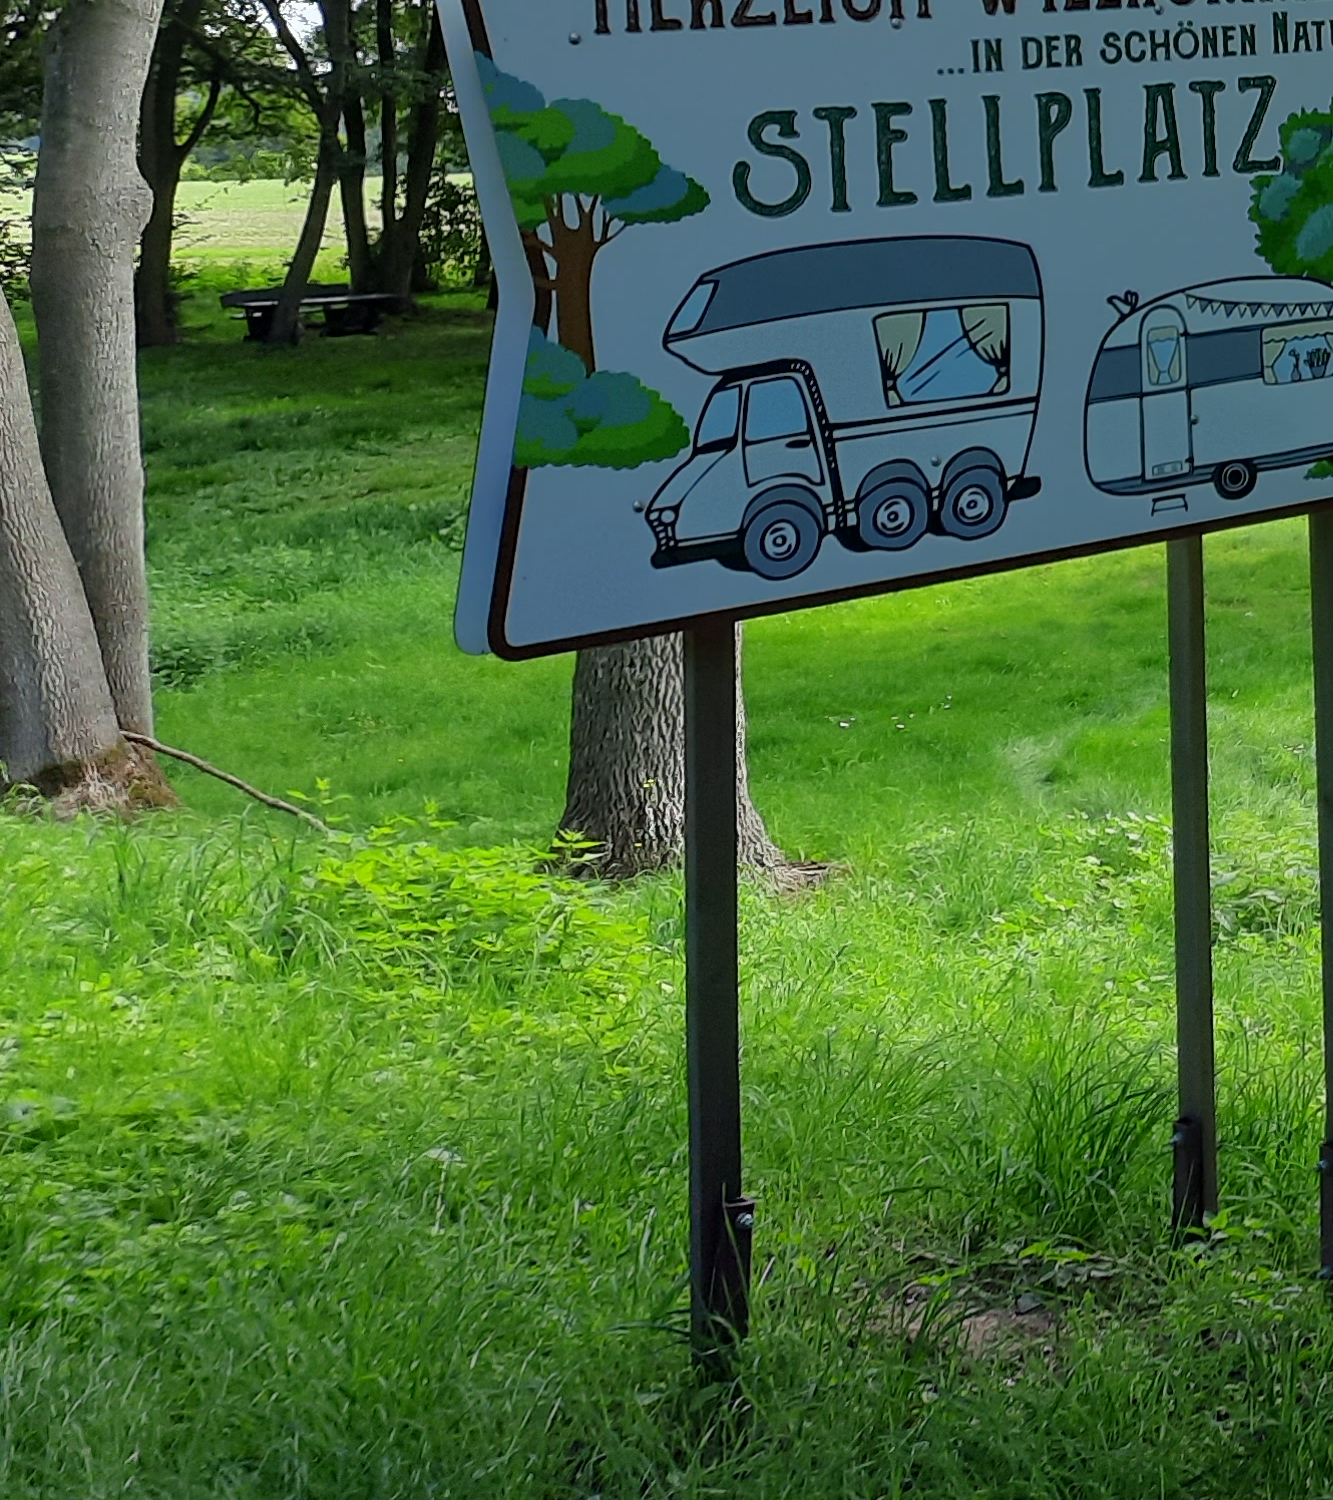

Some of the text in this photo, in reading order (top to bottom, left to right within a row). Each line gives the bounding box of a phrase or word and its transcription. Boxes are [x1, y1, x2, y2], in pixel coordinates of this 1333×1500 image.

[1021, 34, 1083, 69] DER
[1100, 20, 1257, 64] SCHÖNEN
[732, 75, 1281, 218] STELLPLATZ
